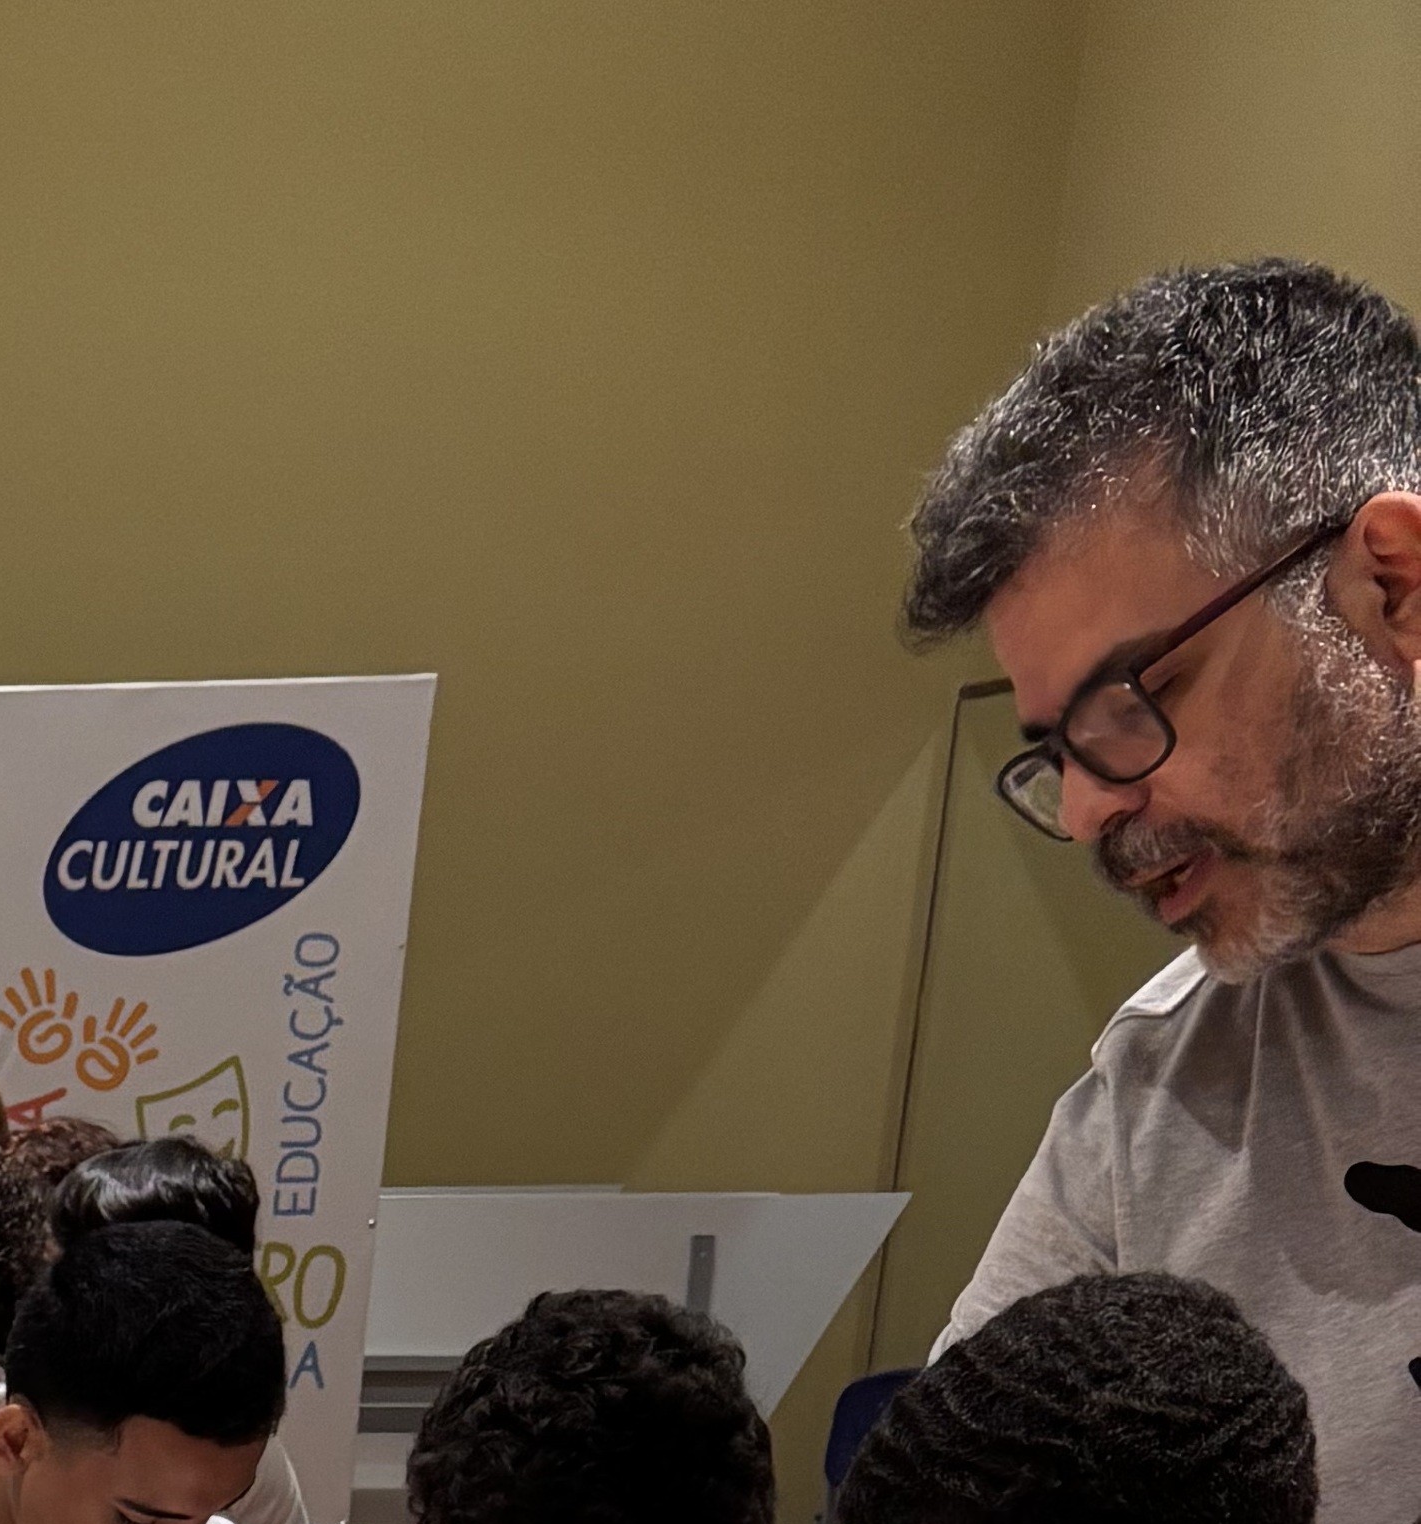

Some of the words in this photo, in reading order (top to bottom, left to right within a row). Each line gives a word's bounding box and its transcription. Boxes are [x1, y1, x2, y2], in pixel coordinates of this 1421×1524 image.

[132, 779, 314, 828] CAIXA
[57, 837, 305, 891] CULTURAL
[272, 931, 341, 1218] EDUCAÇÃO
